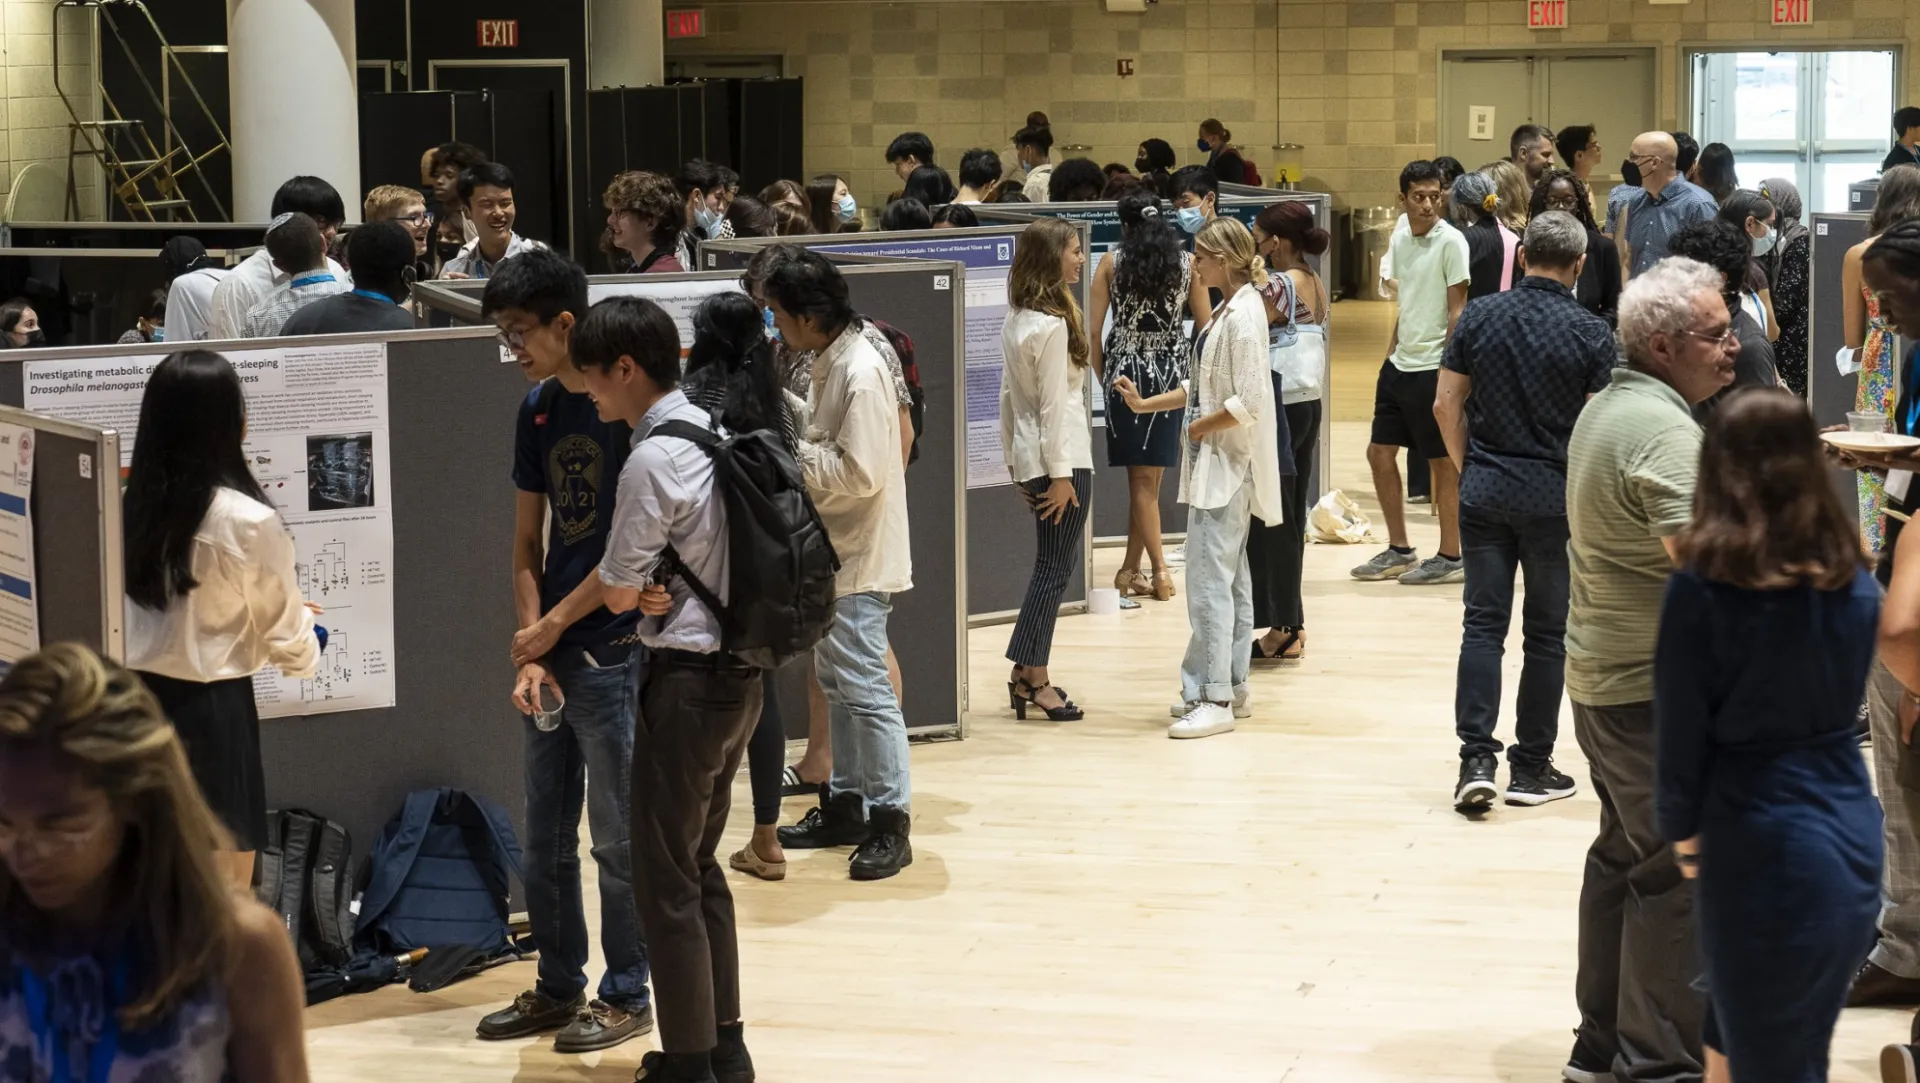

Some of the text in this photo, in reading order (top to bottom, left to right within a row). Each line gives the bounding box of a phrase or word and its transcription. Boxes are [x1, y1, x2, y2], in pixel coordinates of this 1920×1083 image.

[1530, 1, 1564, 26] EXIT
[1774, 0, 1808, 23] EXIT
[482, 20, 515, 46] EXIT
[669, 11, 699, 36] EXIT
[936, 278, 948, 288] 42
[29, 368, 92, 382] Investigating
[95, 365, 144, 377] metabolic
[30, 382, 84, 395] Drosophila
[578, 492, 596, 506] 21
